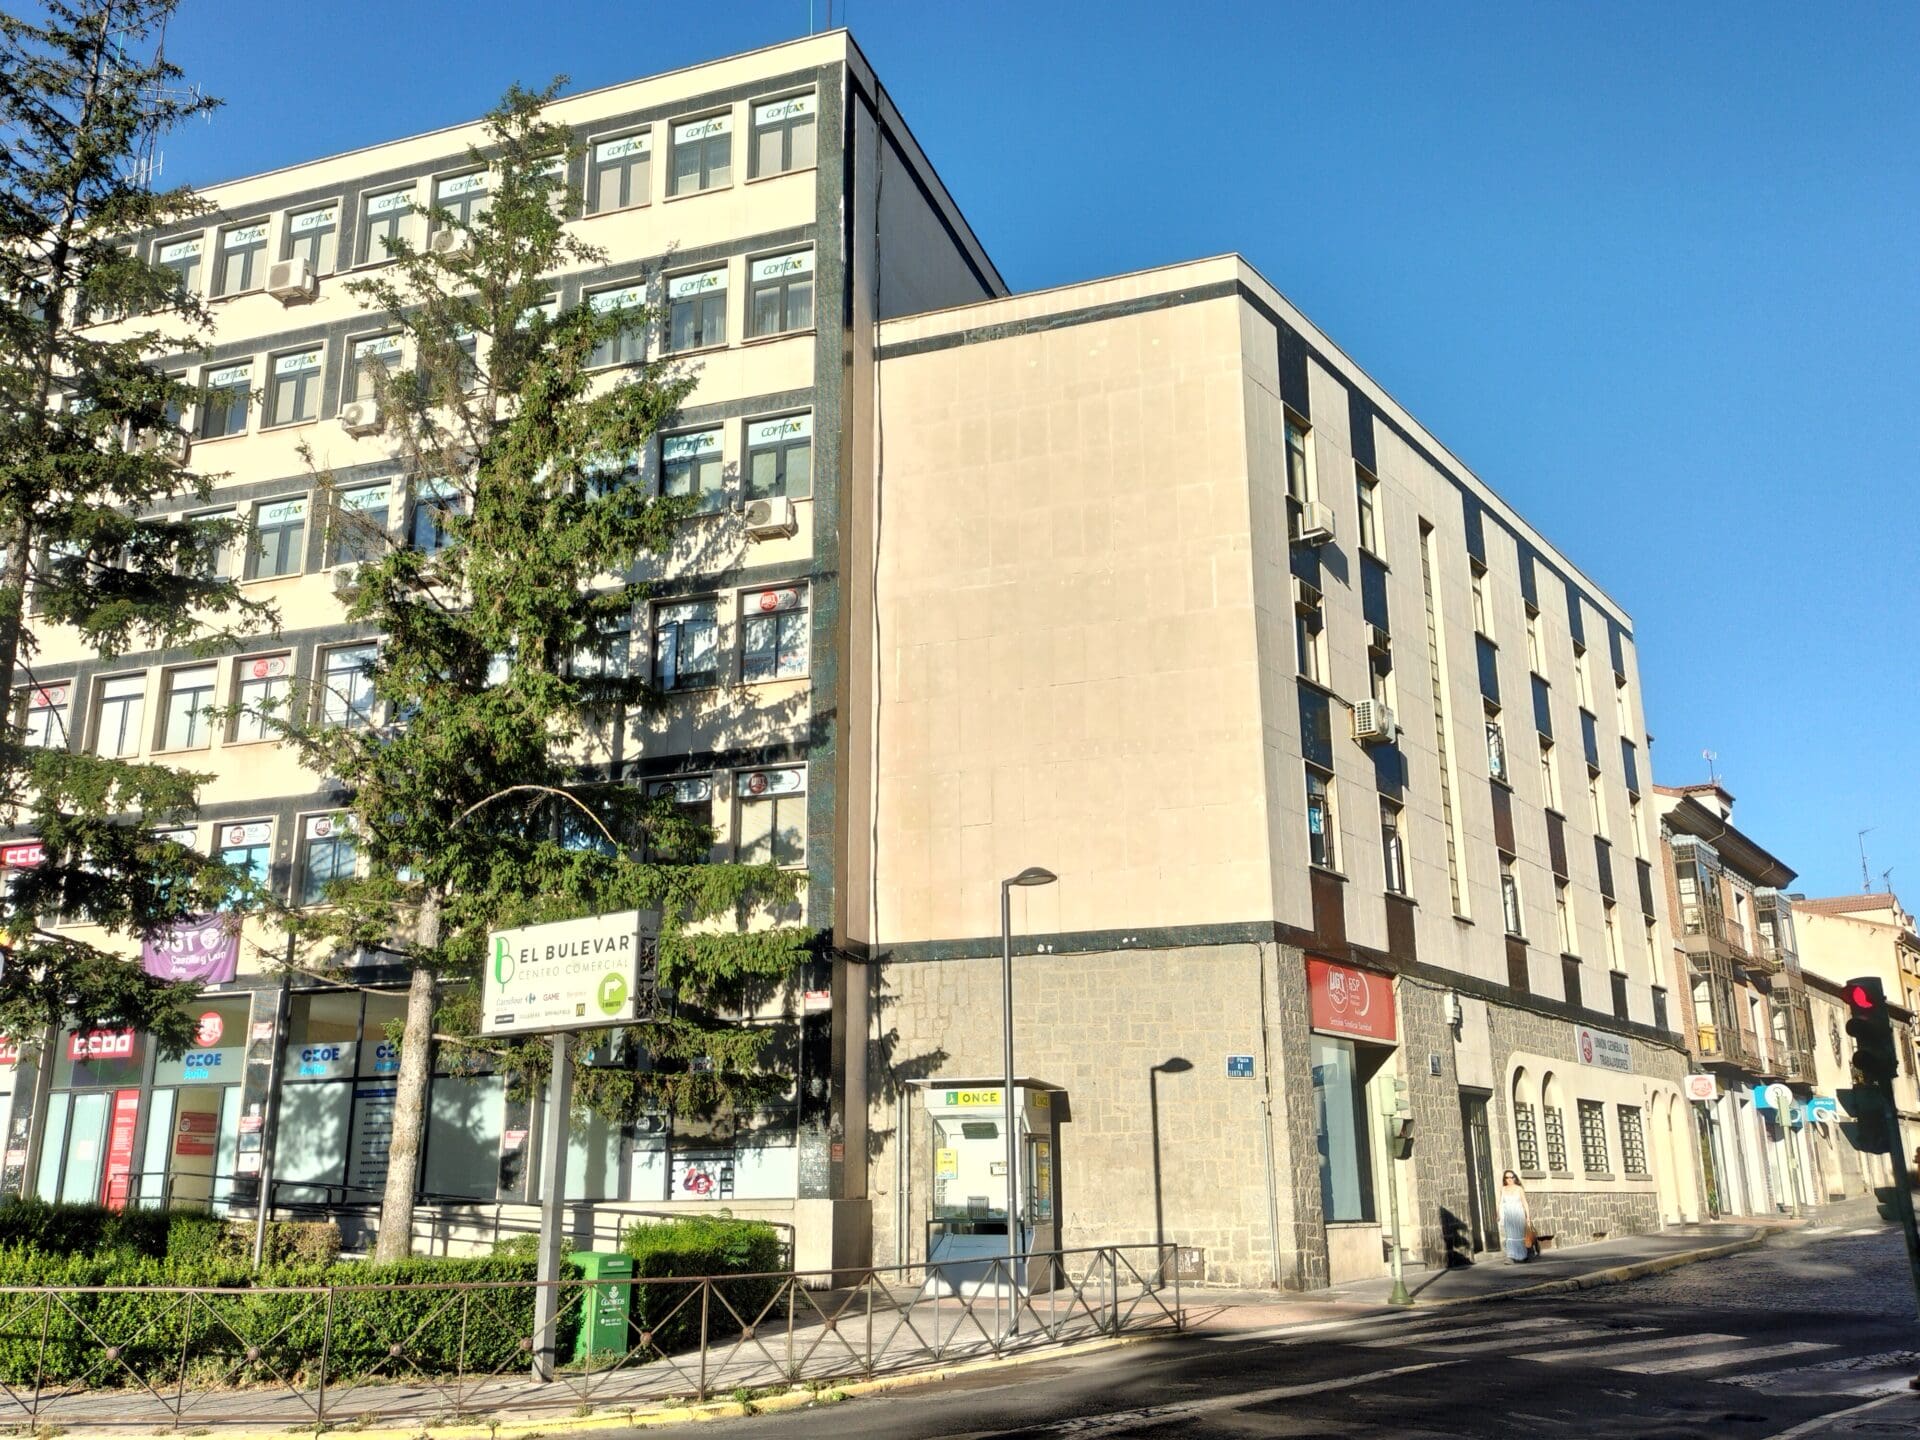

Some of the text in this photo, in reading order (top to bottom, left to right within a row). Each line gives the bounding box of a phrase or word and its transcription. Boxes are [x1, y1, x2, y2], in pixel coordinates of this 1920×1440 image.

[520, 935, 630, 963] EL BULEVAR
[518, 959, 628, 980] CENTRO COMERCIAL
[543, 993, 560, 1001] GAME
[962, 1093, 998, 1103] ONCE
